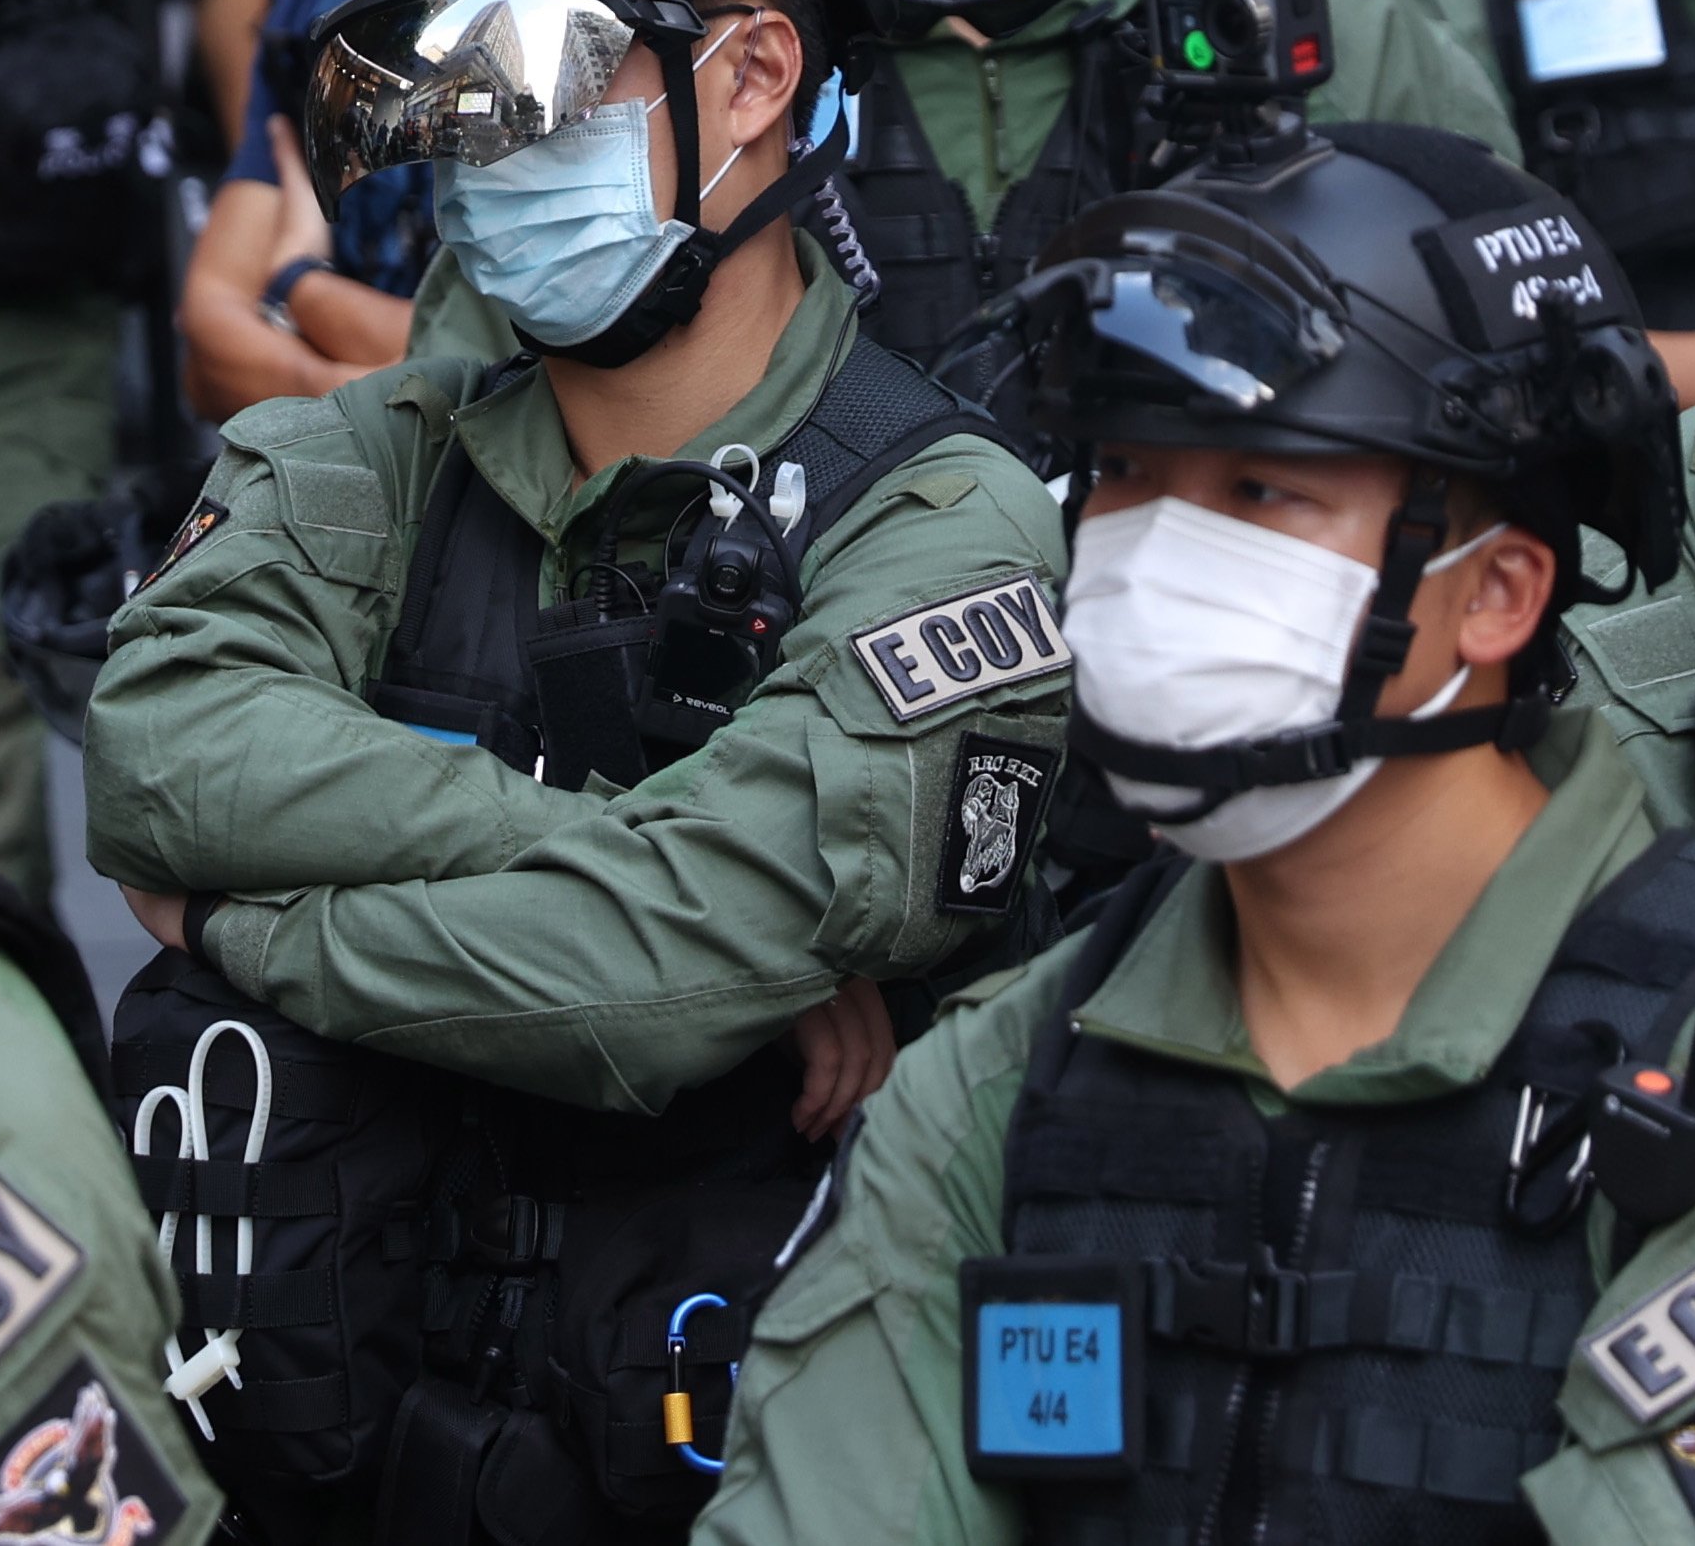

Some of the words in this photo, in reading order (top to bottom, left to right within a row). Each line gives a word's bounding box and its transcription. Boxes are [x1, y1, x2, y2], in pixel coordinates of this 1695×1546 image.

[1473, 223, 1543, 274] PTU
[1533, 214, 1583, 257] E4
[869, 632, 936, 703] E
[919, 585, 1056, 682] COY
[999, 1326, 1056, 1364] PTU
[1064, 1326, 1100, 1364] E4
[1608, 1323, 1687, 1398] E
[1026, 1390, 1069, 1428] 4/4
